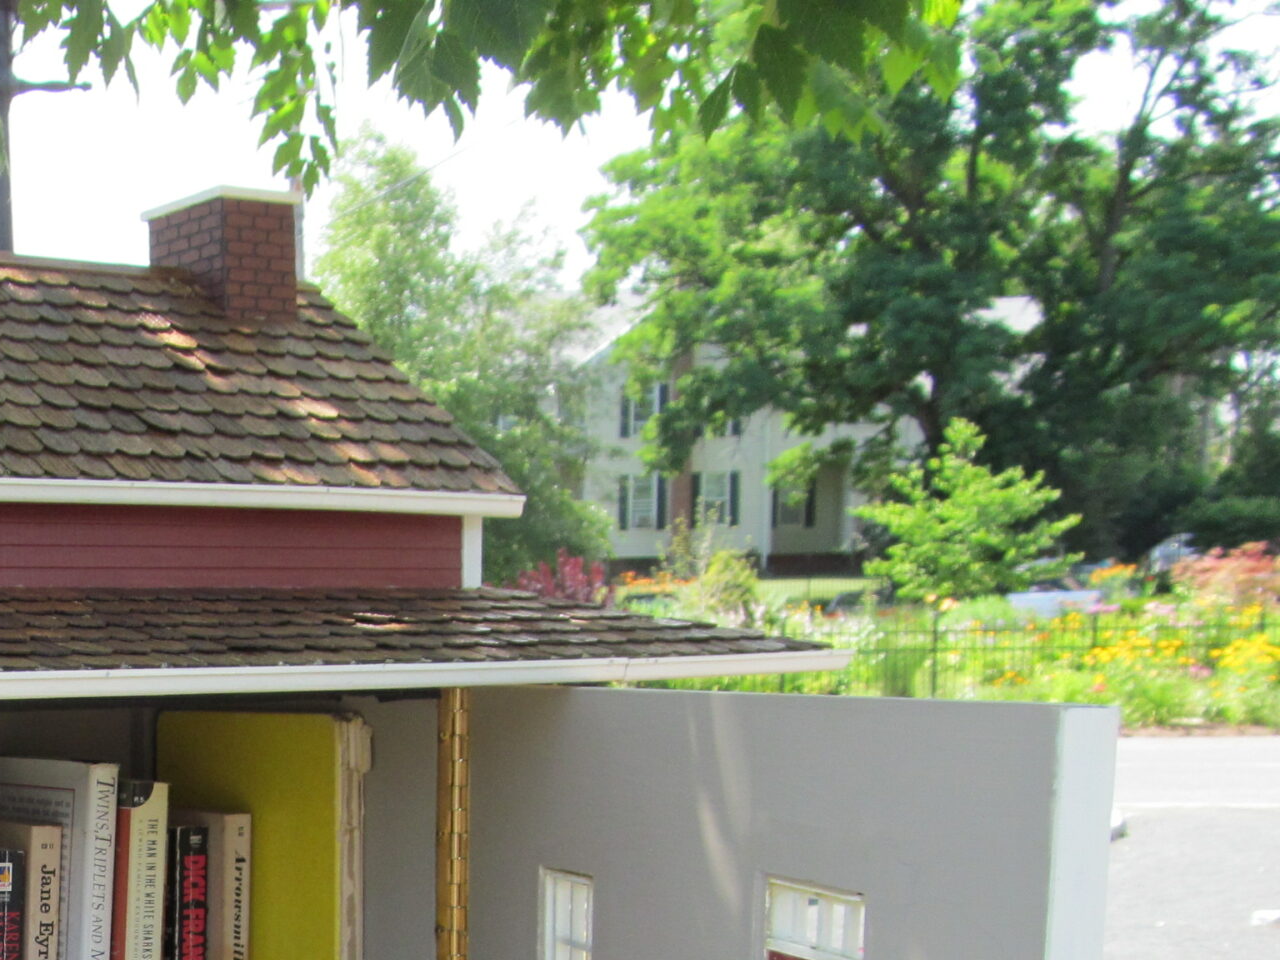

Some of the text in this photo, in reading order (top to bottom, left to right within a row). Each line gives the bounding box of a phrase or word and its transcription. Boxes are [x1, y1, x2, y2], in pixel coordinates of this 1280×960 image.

[147, 819, 159, 835] THE
[146, 839, 158, 858] MAN
[92, 833, 113, 911] TRIPLETS
[146, 862, 157, 871] IN
[40, 864, 56, 914] Jane
[145, 874, 156, 889] THE
[182, 855, 206, 903] DICK
[143, 891, 156, 919] WHITE
